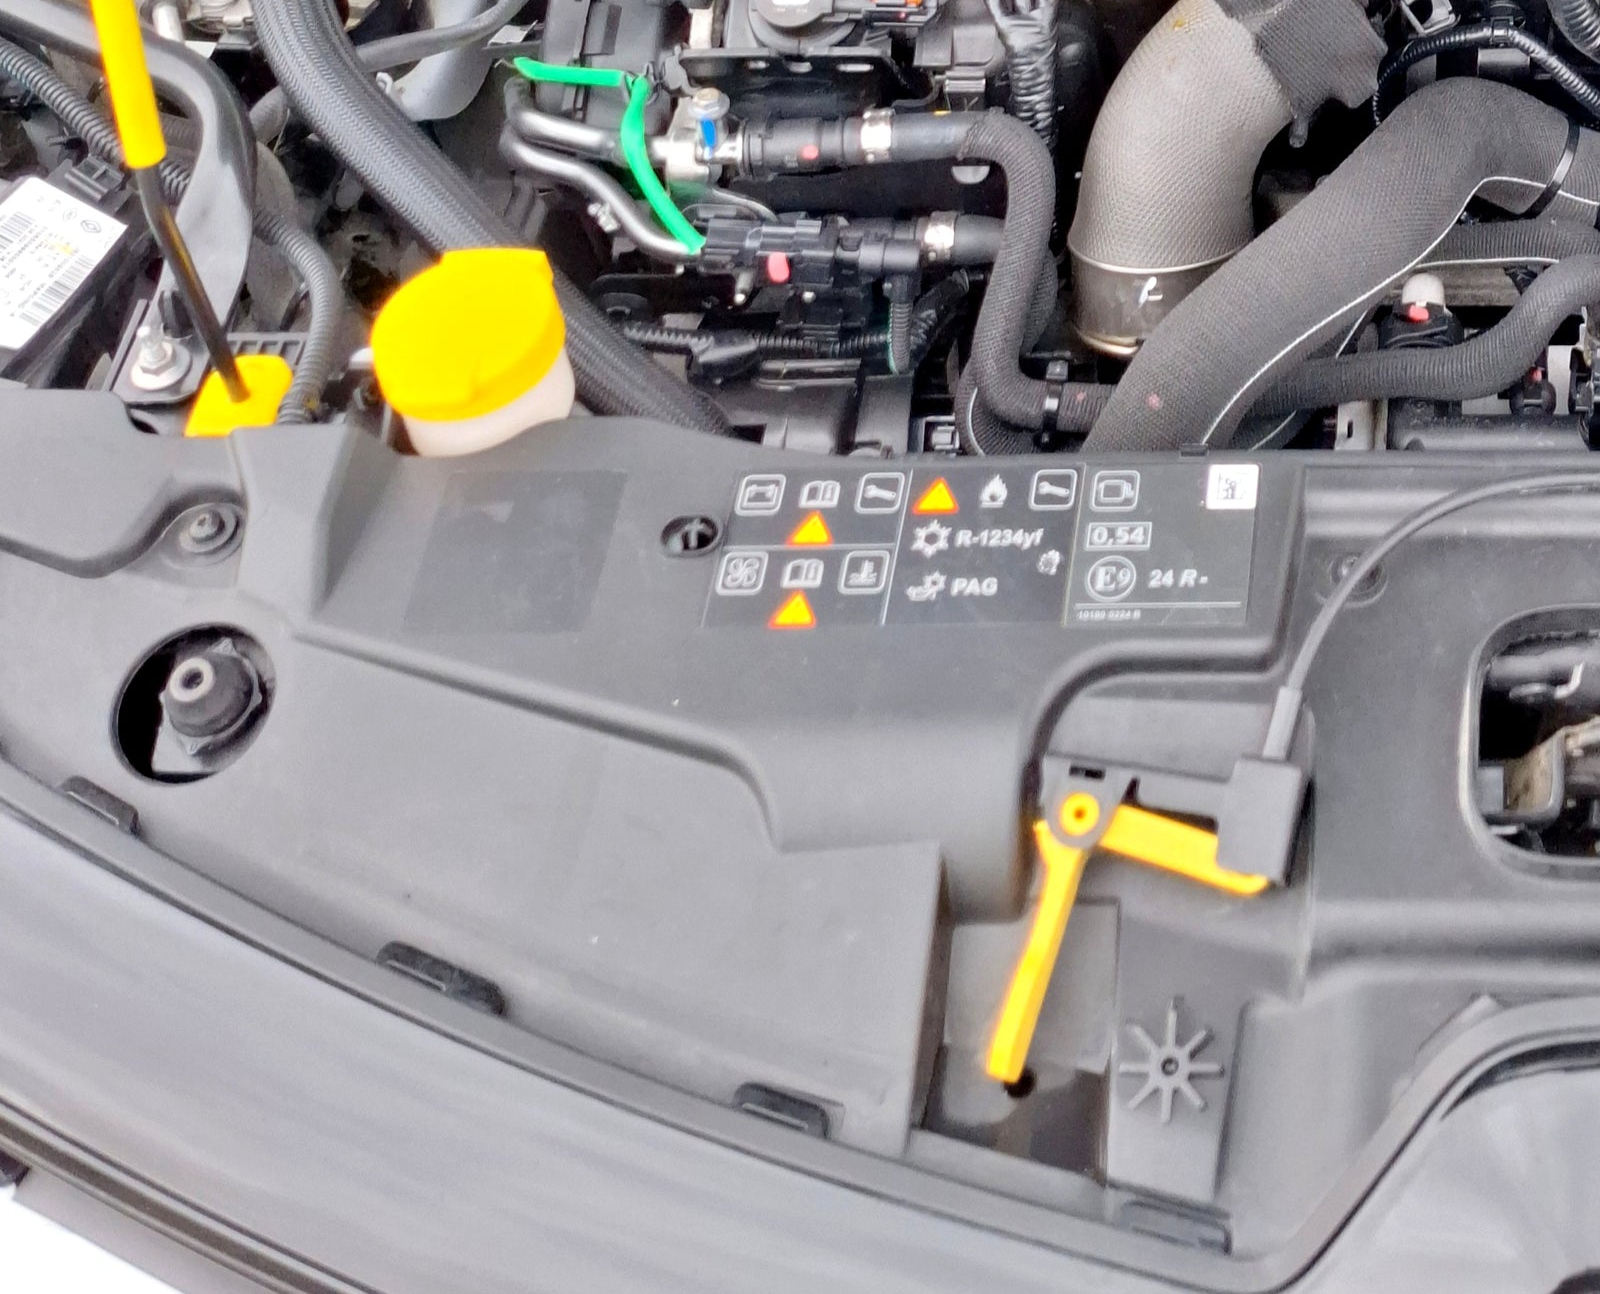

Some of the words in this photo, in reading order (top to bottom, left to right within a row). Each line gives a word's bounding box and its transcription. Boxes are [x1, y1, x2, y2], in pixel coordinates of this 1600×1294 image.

[954, 527, 1045, 550] R-1234yf
[1091, 525, 1146, 547] 0,54
[950, 576, 999, 597] PAG
[1149, 569, 1174, 588] 24
